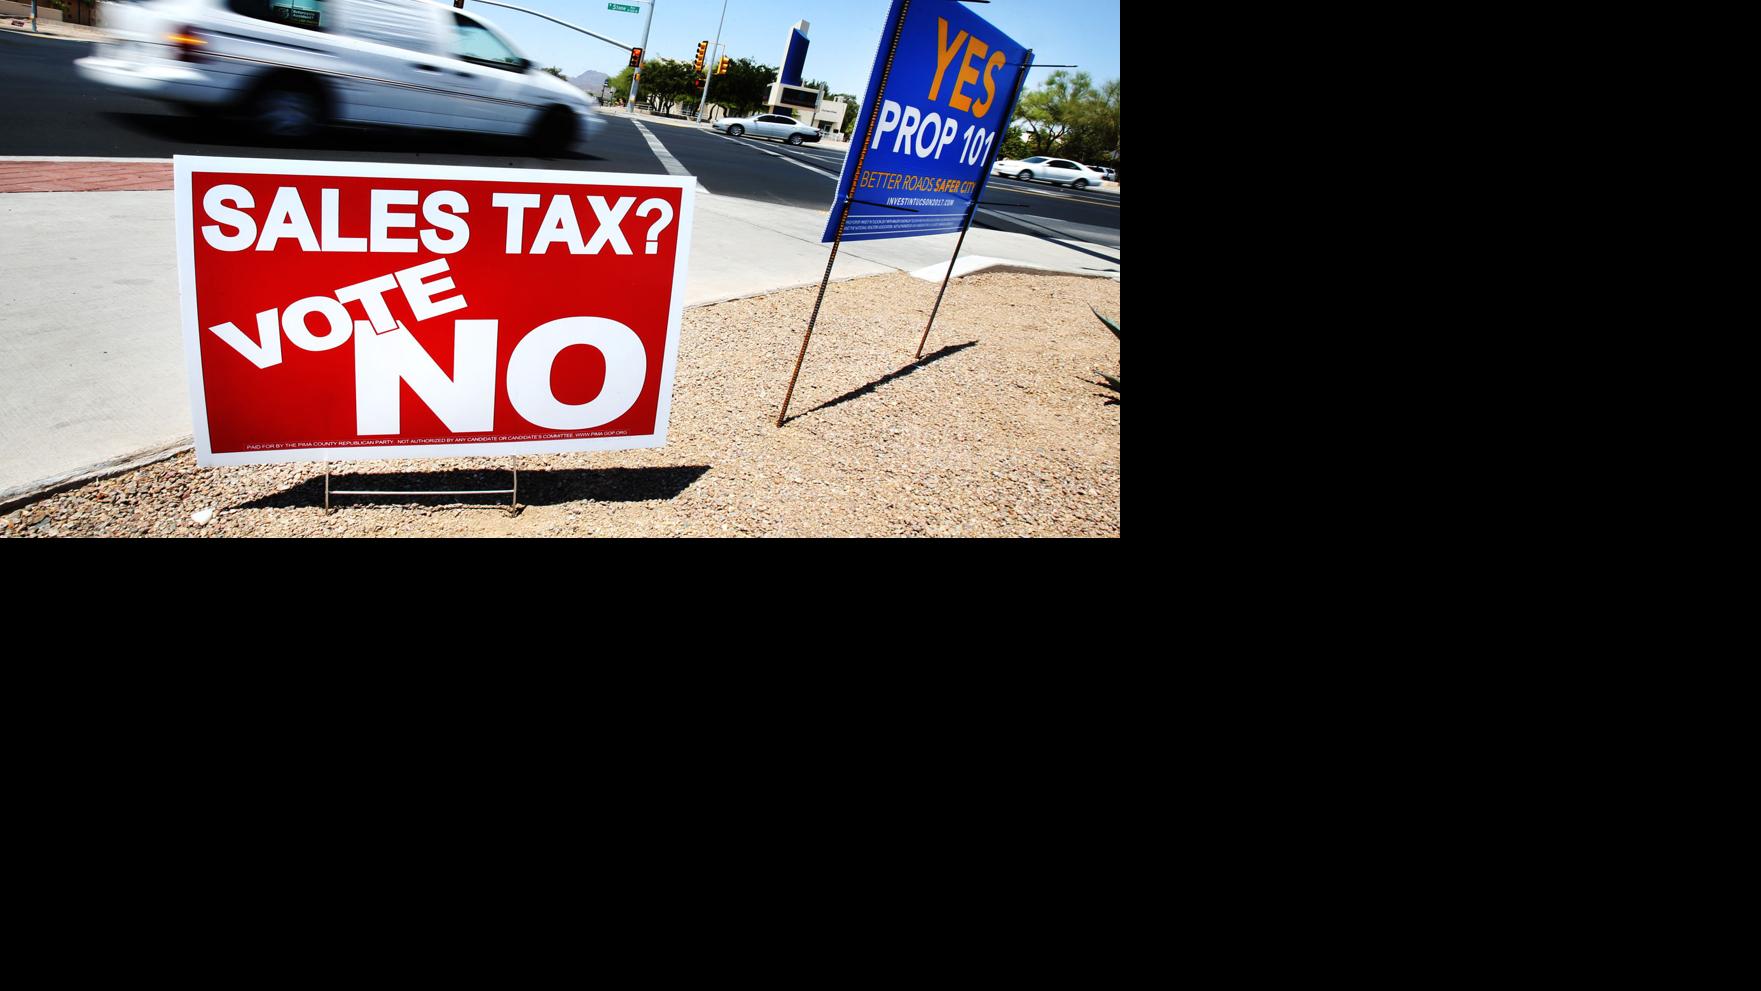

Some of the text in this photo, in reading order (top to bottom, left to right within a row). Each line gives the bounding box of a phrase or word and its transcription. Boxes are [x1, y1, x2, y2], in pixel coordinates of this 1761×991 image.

[927, 16, 1006, 118] YES
[871, 99, 996, 168] PROP 101
[860, 170, 977, 194] BETTER ROADS SAFER CITY
[886, 197, 955, 207] INVESTINTUCSON2017.COM
[201, 184, 674, 255] SALES TAX?
[208, 257, 468, 369] VOTE
[354, 316, 647, 436] NO
